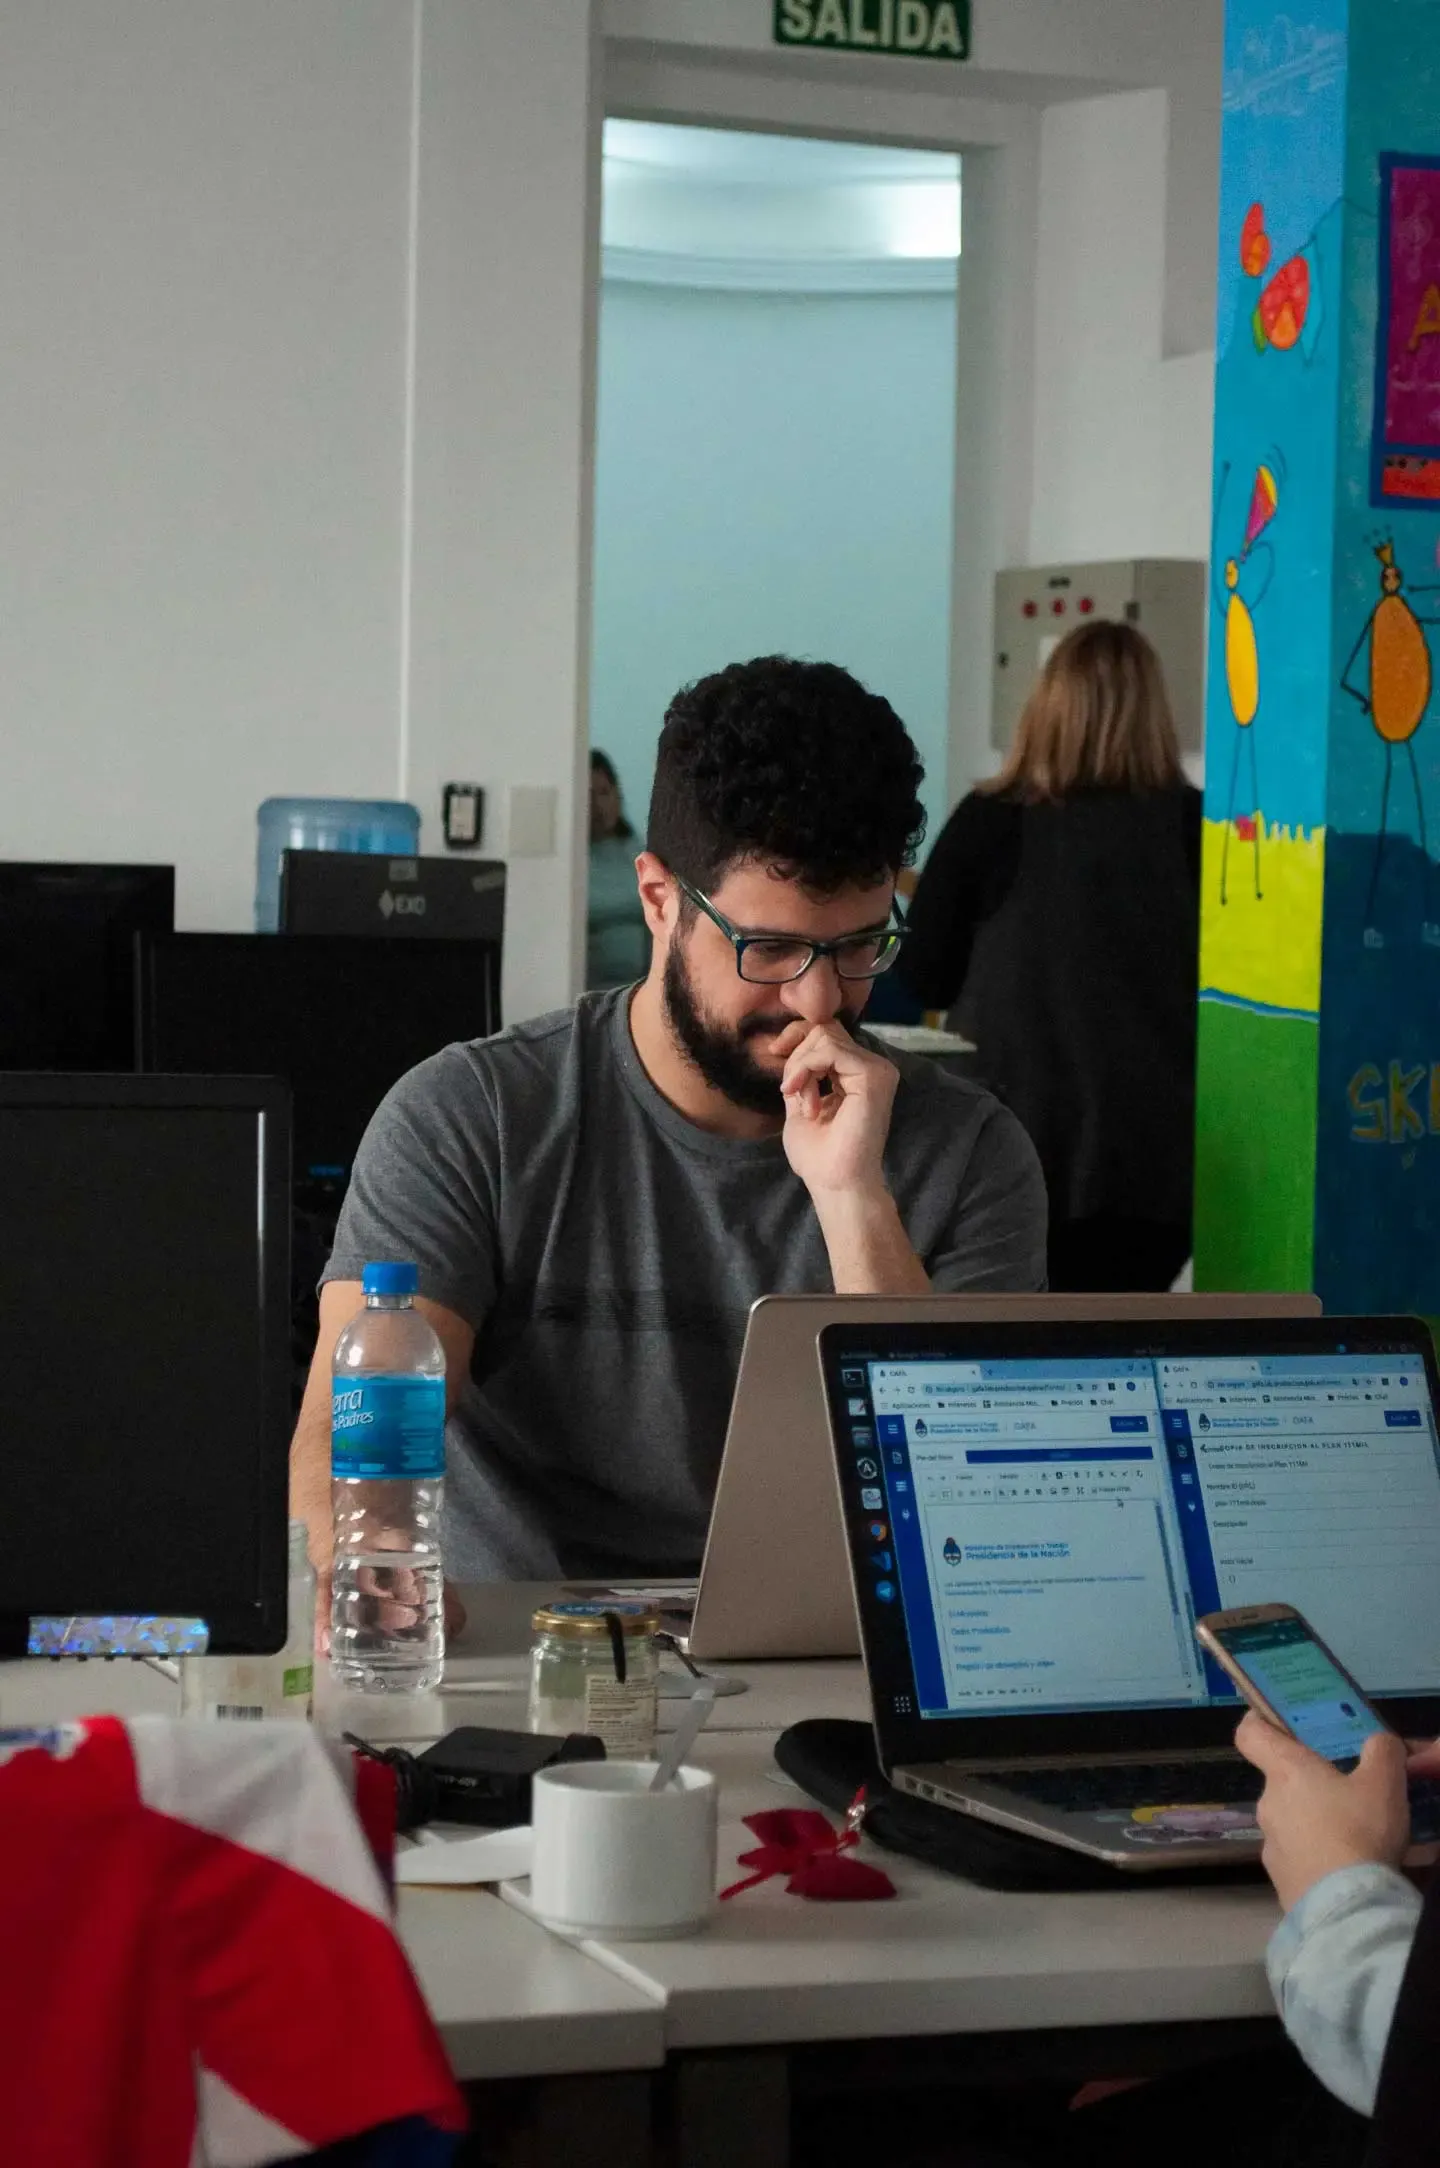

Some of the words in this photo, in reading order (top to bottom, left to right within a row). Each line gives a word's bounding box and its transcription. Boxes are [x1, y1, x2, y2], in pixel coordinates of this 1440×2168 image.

[779, 0, 963, 54] SALIDA
[965, 1551, 1016, 1559] Presidencia
[1017, 1550, 1028, 1558] de
[1030, 1550, 1038, 1558] la
[1040, 1549, 1070, 1558] Nación
